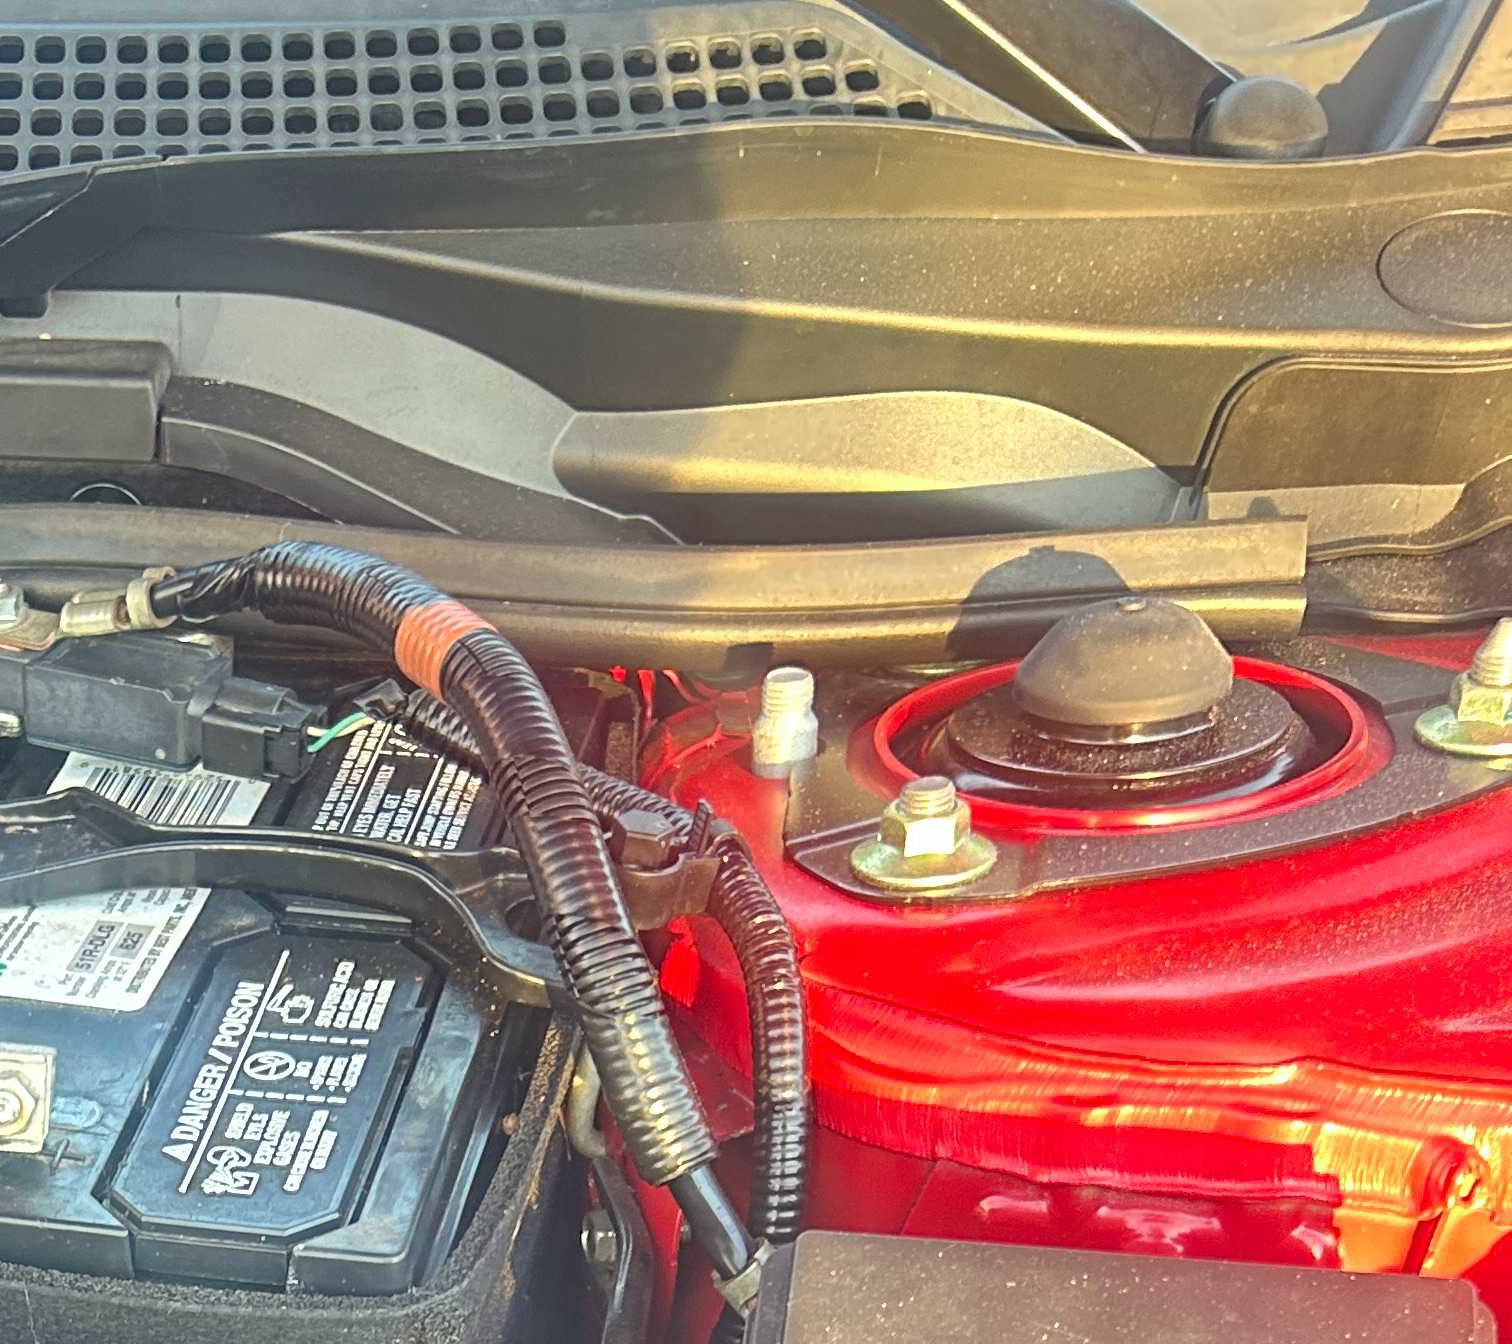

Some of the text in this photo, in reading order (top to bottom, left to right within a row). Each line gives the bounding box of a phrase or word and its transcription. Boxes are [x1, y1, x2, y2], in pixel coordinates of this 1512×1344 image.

[400, 787, 422, 808] FAST
[392, 807, 414, 828] HELP
[75, 923, 118, 972] 51R-DLG
[119, 930, 144, 951] 625
[170, 1063, 230, 1142] DANGER
[212, 980, 265, 1048] POISON
